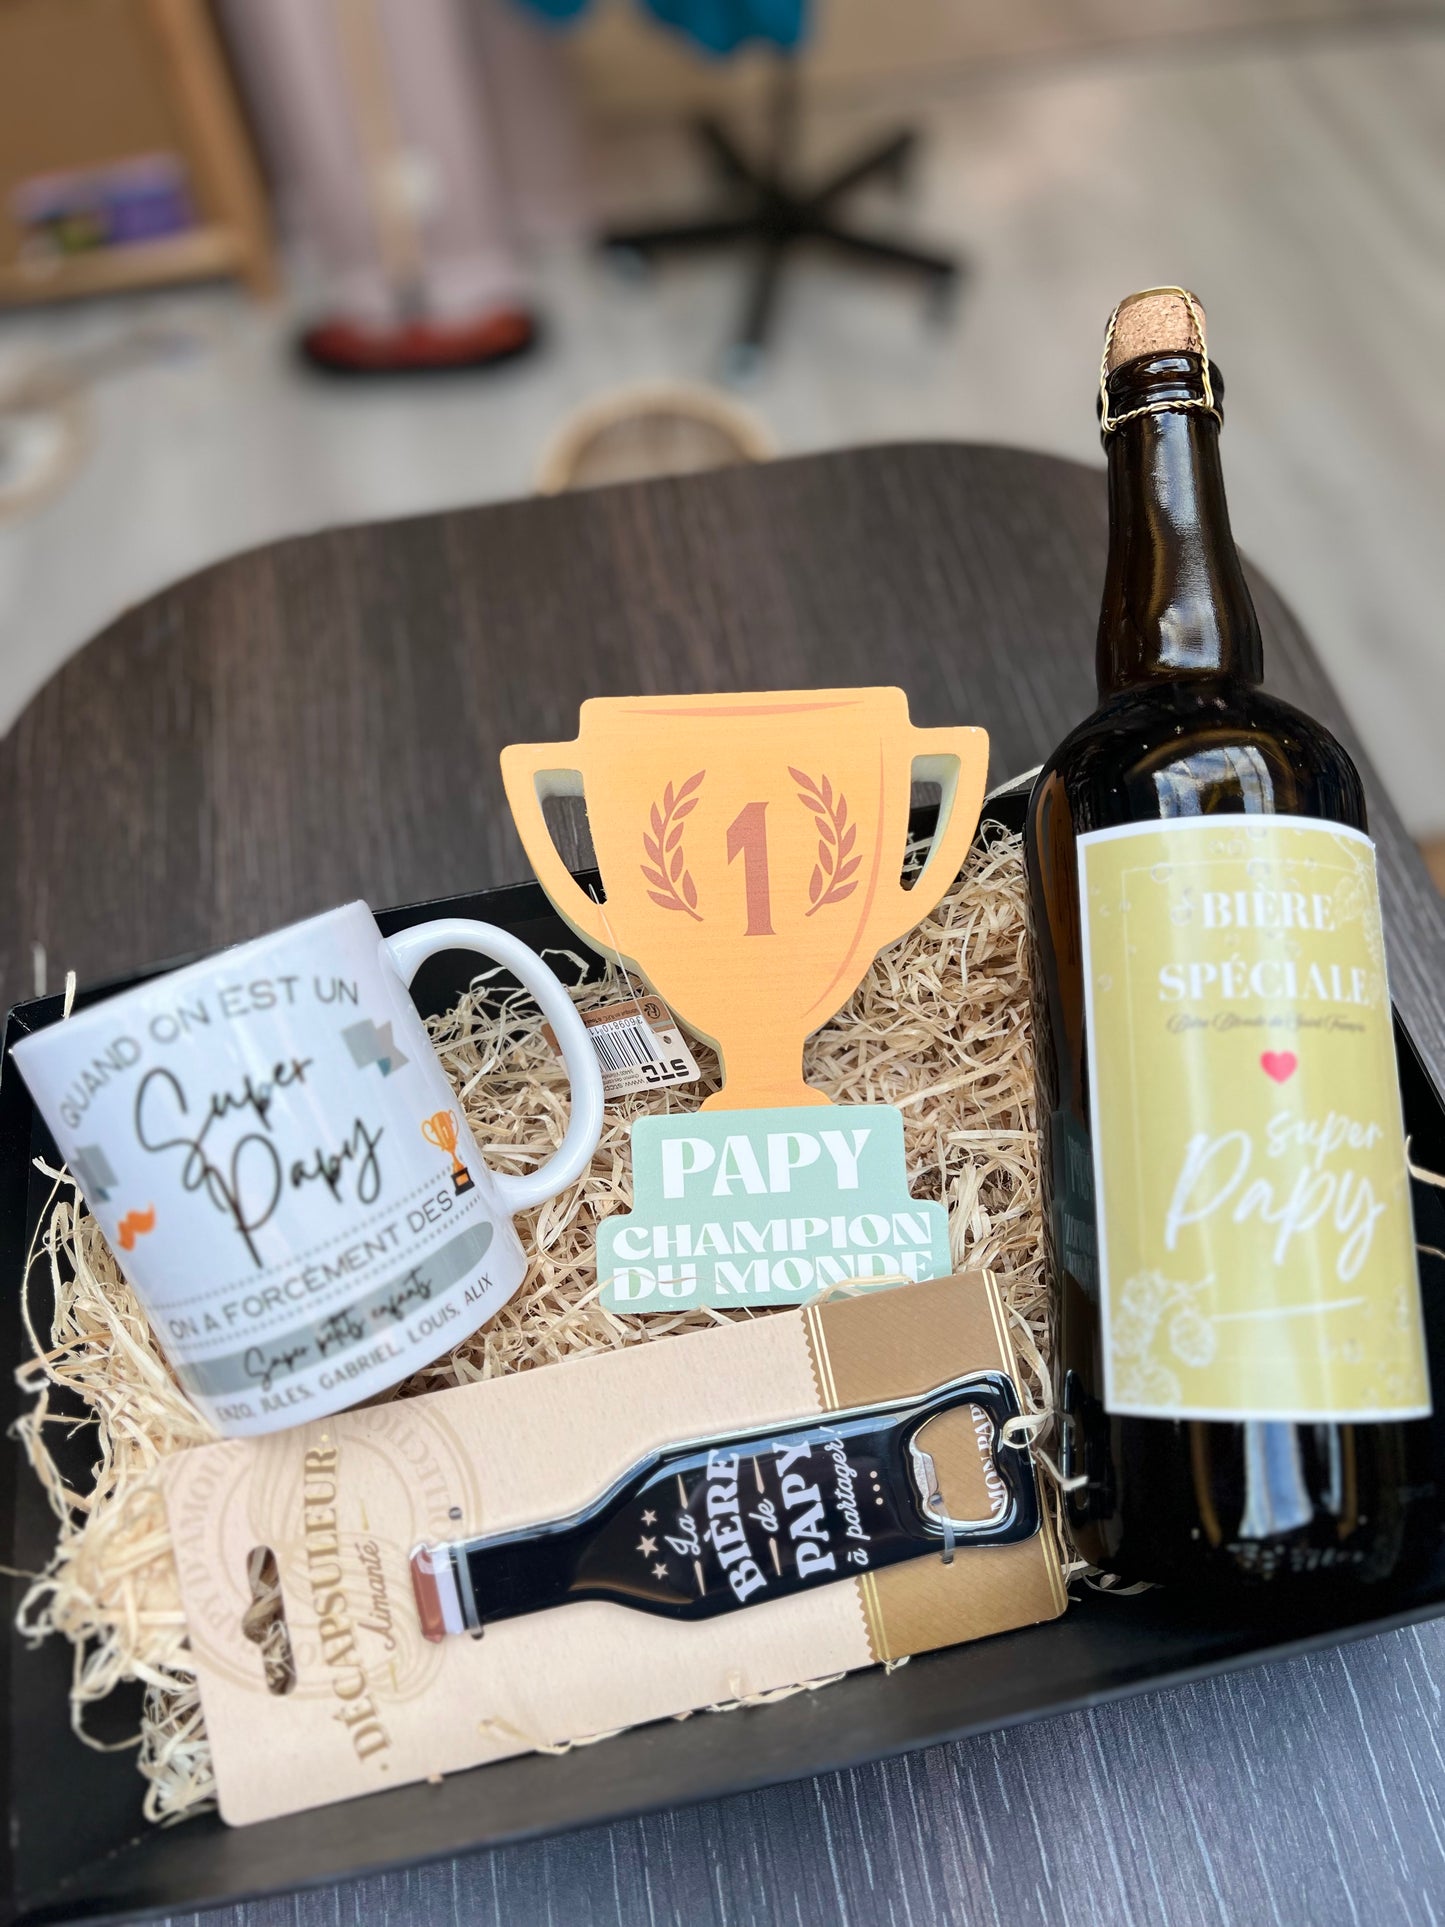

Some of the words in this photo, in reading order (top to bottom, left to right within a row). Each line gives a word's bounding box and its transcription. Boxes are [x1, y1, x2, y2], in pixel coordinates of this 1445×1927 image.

[726, 801, 777, 937] 1
[1201, 882, 1336, 932] BIÈRE
[1158, 953, 1370, 1006] SPÉCIALE
[59, 1036, 142, 1131] QUAND
[149, 998, 210, 1045] ON
[218, 976, 300, 1018] EST
[313, 977, 359, 1006] UN
[641, 1058, 690, 1083] STC
[134, 1055, 314, 1193] Super
[1265, 1108, 1384, 1167] super
[204, 1118, 385, 1269] Papy
[661, 1128, 873, 1199] PAPY
[612, 1211, 933, 1261] CHAMPION
[1163, 1130, 1386, 1283] Papy
[168, 1315, 198, 1341] ON
[203, 1309, 222, 1331] A
[221, 1224, 400, 1325] FORCÉMENT
[408, 1188, 455, 1233] DES
[464, 1272, 494, 1306] ALIX
[612, 1263, 697, 1301] DU
[714, 1250, 935, 1296] MONDE
[969, 1404, 992, 1451] PAP
[664, 1513, 701, 1557] La
[702, 1448, 768, 1602] BIÈRE
[749, 1498, 780, 1532] de
[772, 1440, 837, 1579] PAPY
[303, 1446, 392, 1764] DÉCAPSULEUR
[355, 1539, 397, 1651] Aimanté
